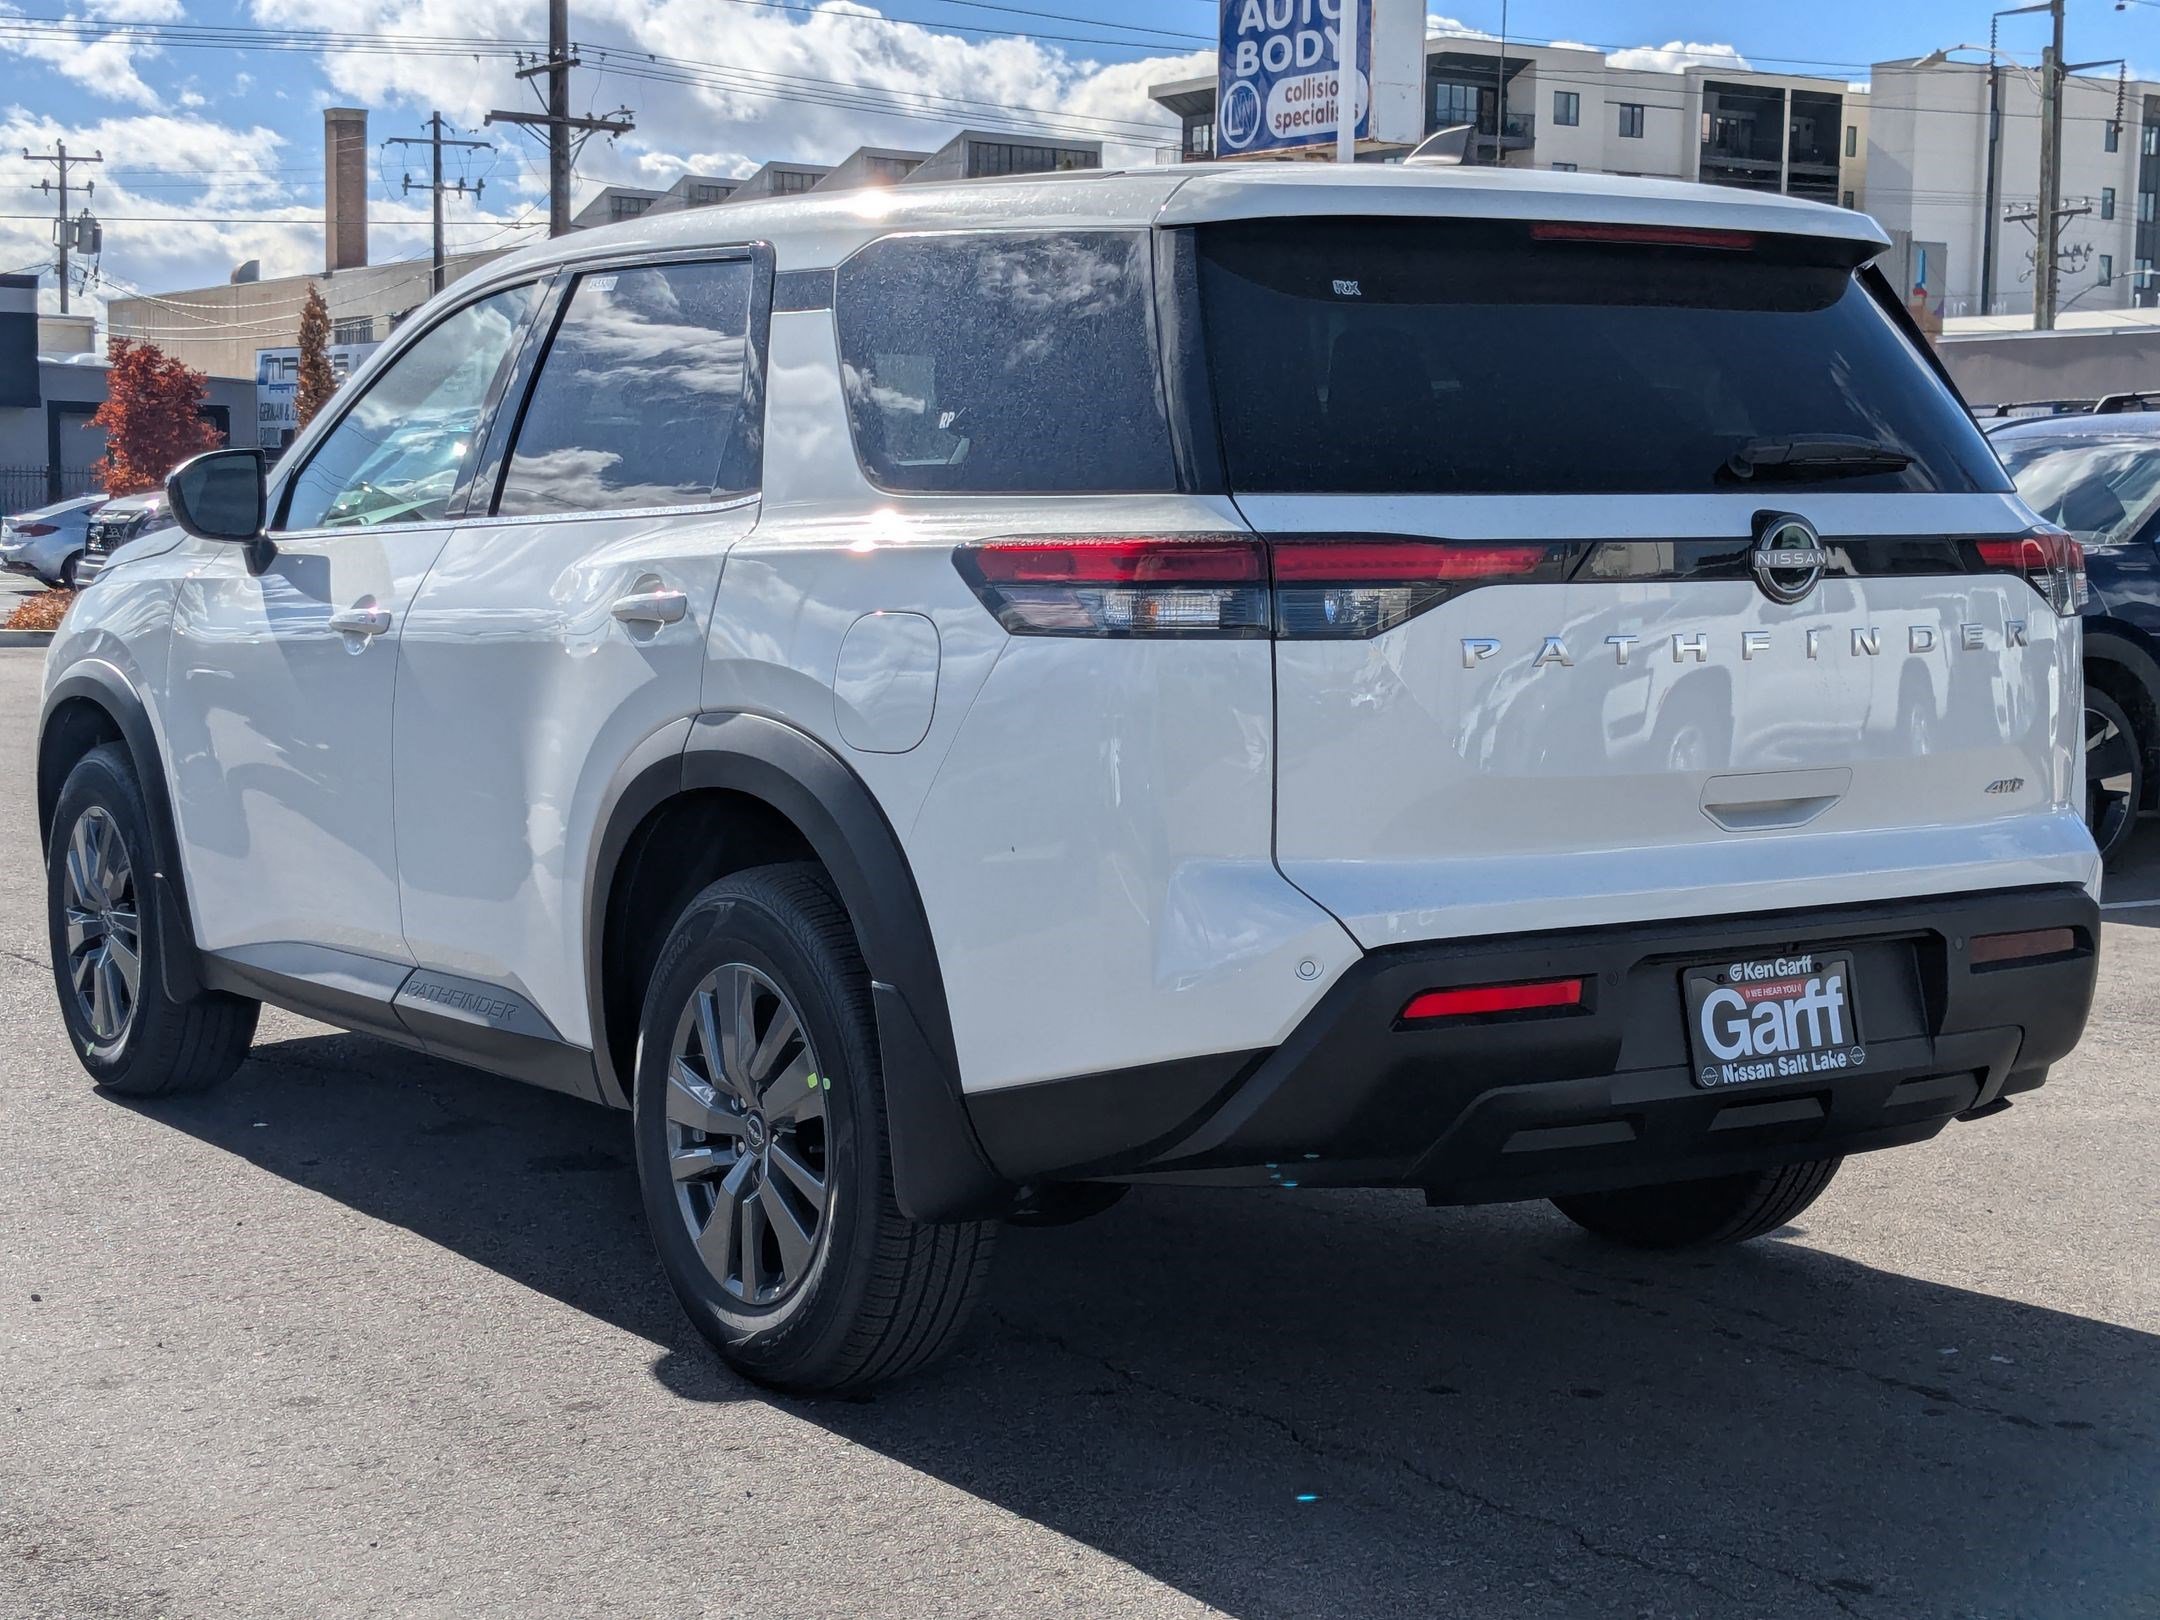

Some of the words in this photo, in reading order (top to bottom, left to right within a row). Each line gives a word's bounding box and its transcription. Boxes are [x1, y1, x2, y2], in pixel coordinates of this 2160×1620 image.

[1285, 75, 1339, 103] collisio
[1757, 553, 1826, 565] NISSAN
[1460, 620, 2028, 669] PATHFINDER
[1743, 962, 1775, 981] Ken
[1775, 955, 1812, 977] Garff
[405, 980, 519, 1022] PATHFINDER
[1750, 988, 1763, 998] WE
[1763, 986, 1783, 996] HEAR
[1783, 984, 1797, 994] YOU
[1701, 975, 1844, 1060] Garff
[1722, 1062, 1775, 1084] Nissan
[1778, 1054, 1808, 1076] Salt
[1811, 1051, 1847, 1071] Lake
